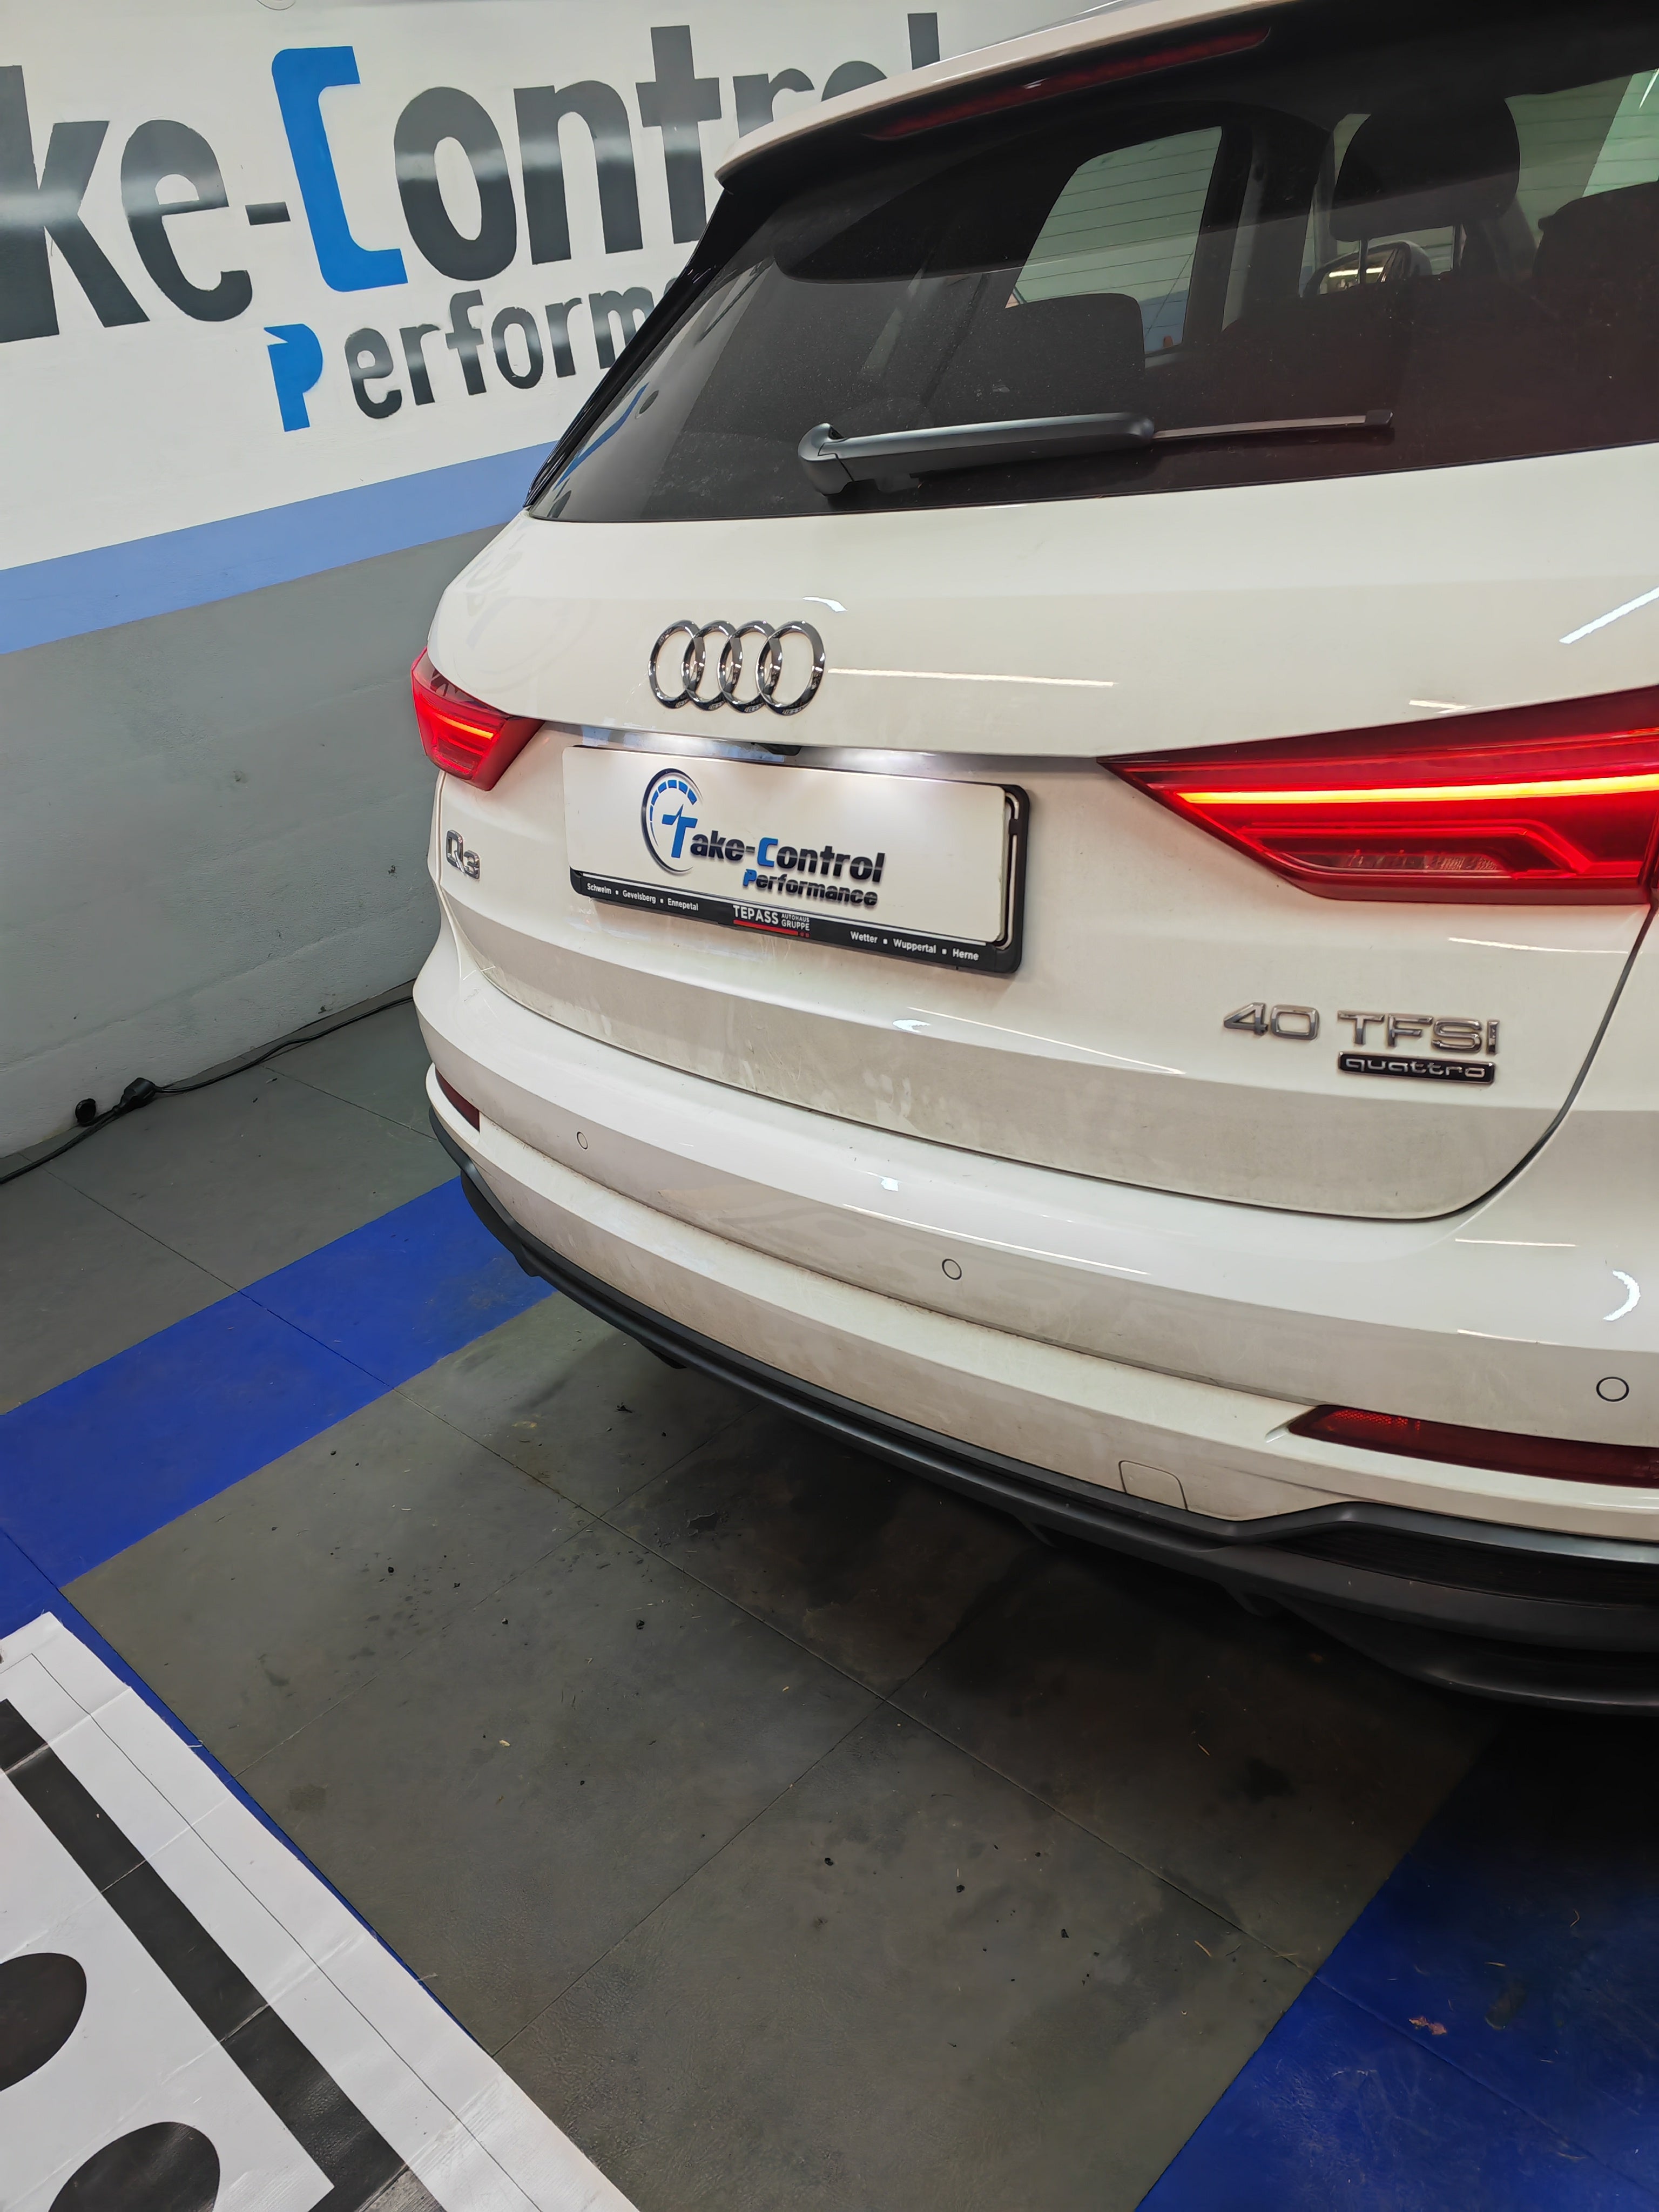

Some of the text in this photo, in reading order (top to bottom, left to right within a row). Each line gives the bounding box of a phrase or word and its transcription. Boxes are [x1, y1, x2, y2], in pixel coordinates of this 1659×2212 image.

[264, 276, 679, 431] Perform
[446, 830, 480, 880] Q3
[662, 804, 886, 883] Take-Control
[623, 890, 656, 903] Gevelsberg
[667, 898, 699, 911] Ennepetal
[743, 868, 878, 907] Performance
[733, 905, 779, 925] TEPASS
[781, 913, 810, 923] AUTOHAUS
[781, 919, 810, 931] GRUPPE
[850, 931, 979, 961] Wetter Wuppertal Herne
[1224, 1002, 1500, 1054] 40 TFSI
[1345, 1056, 1486, 1078] quattro
